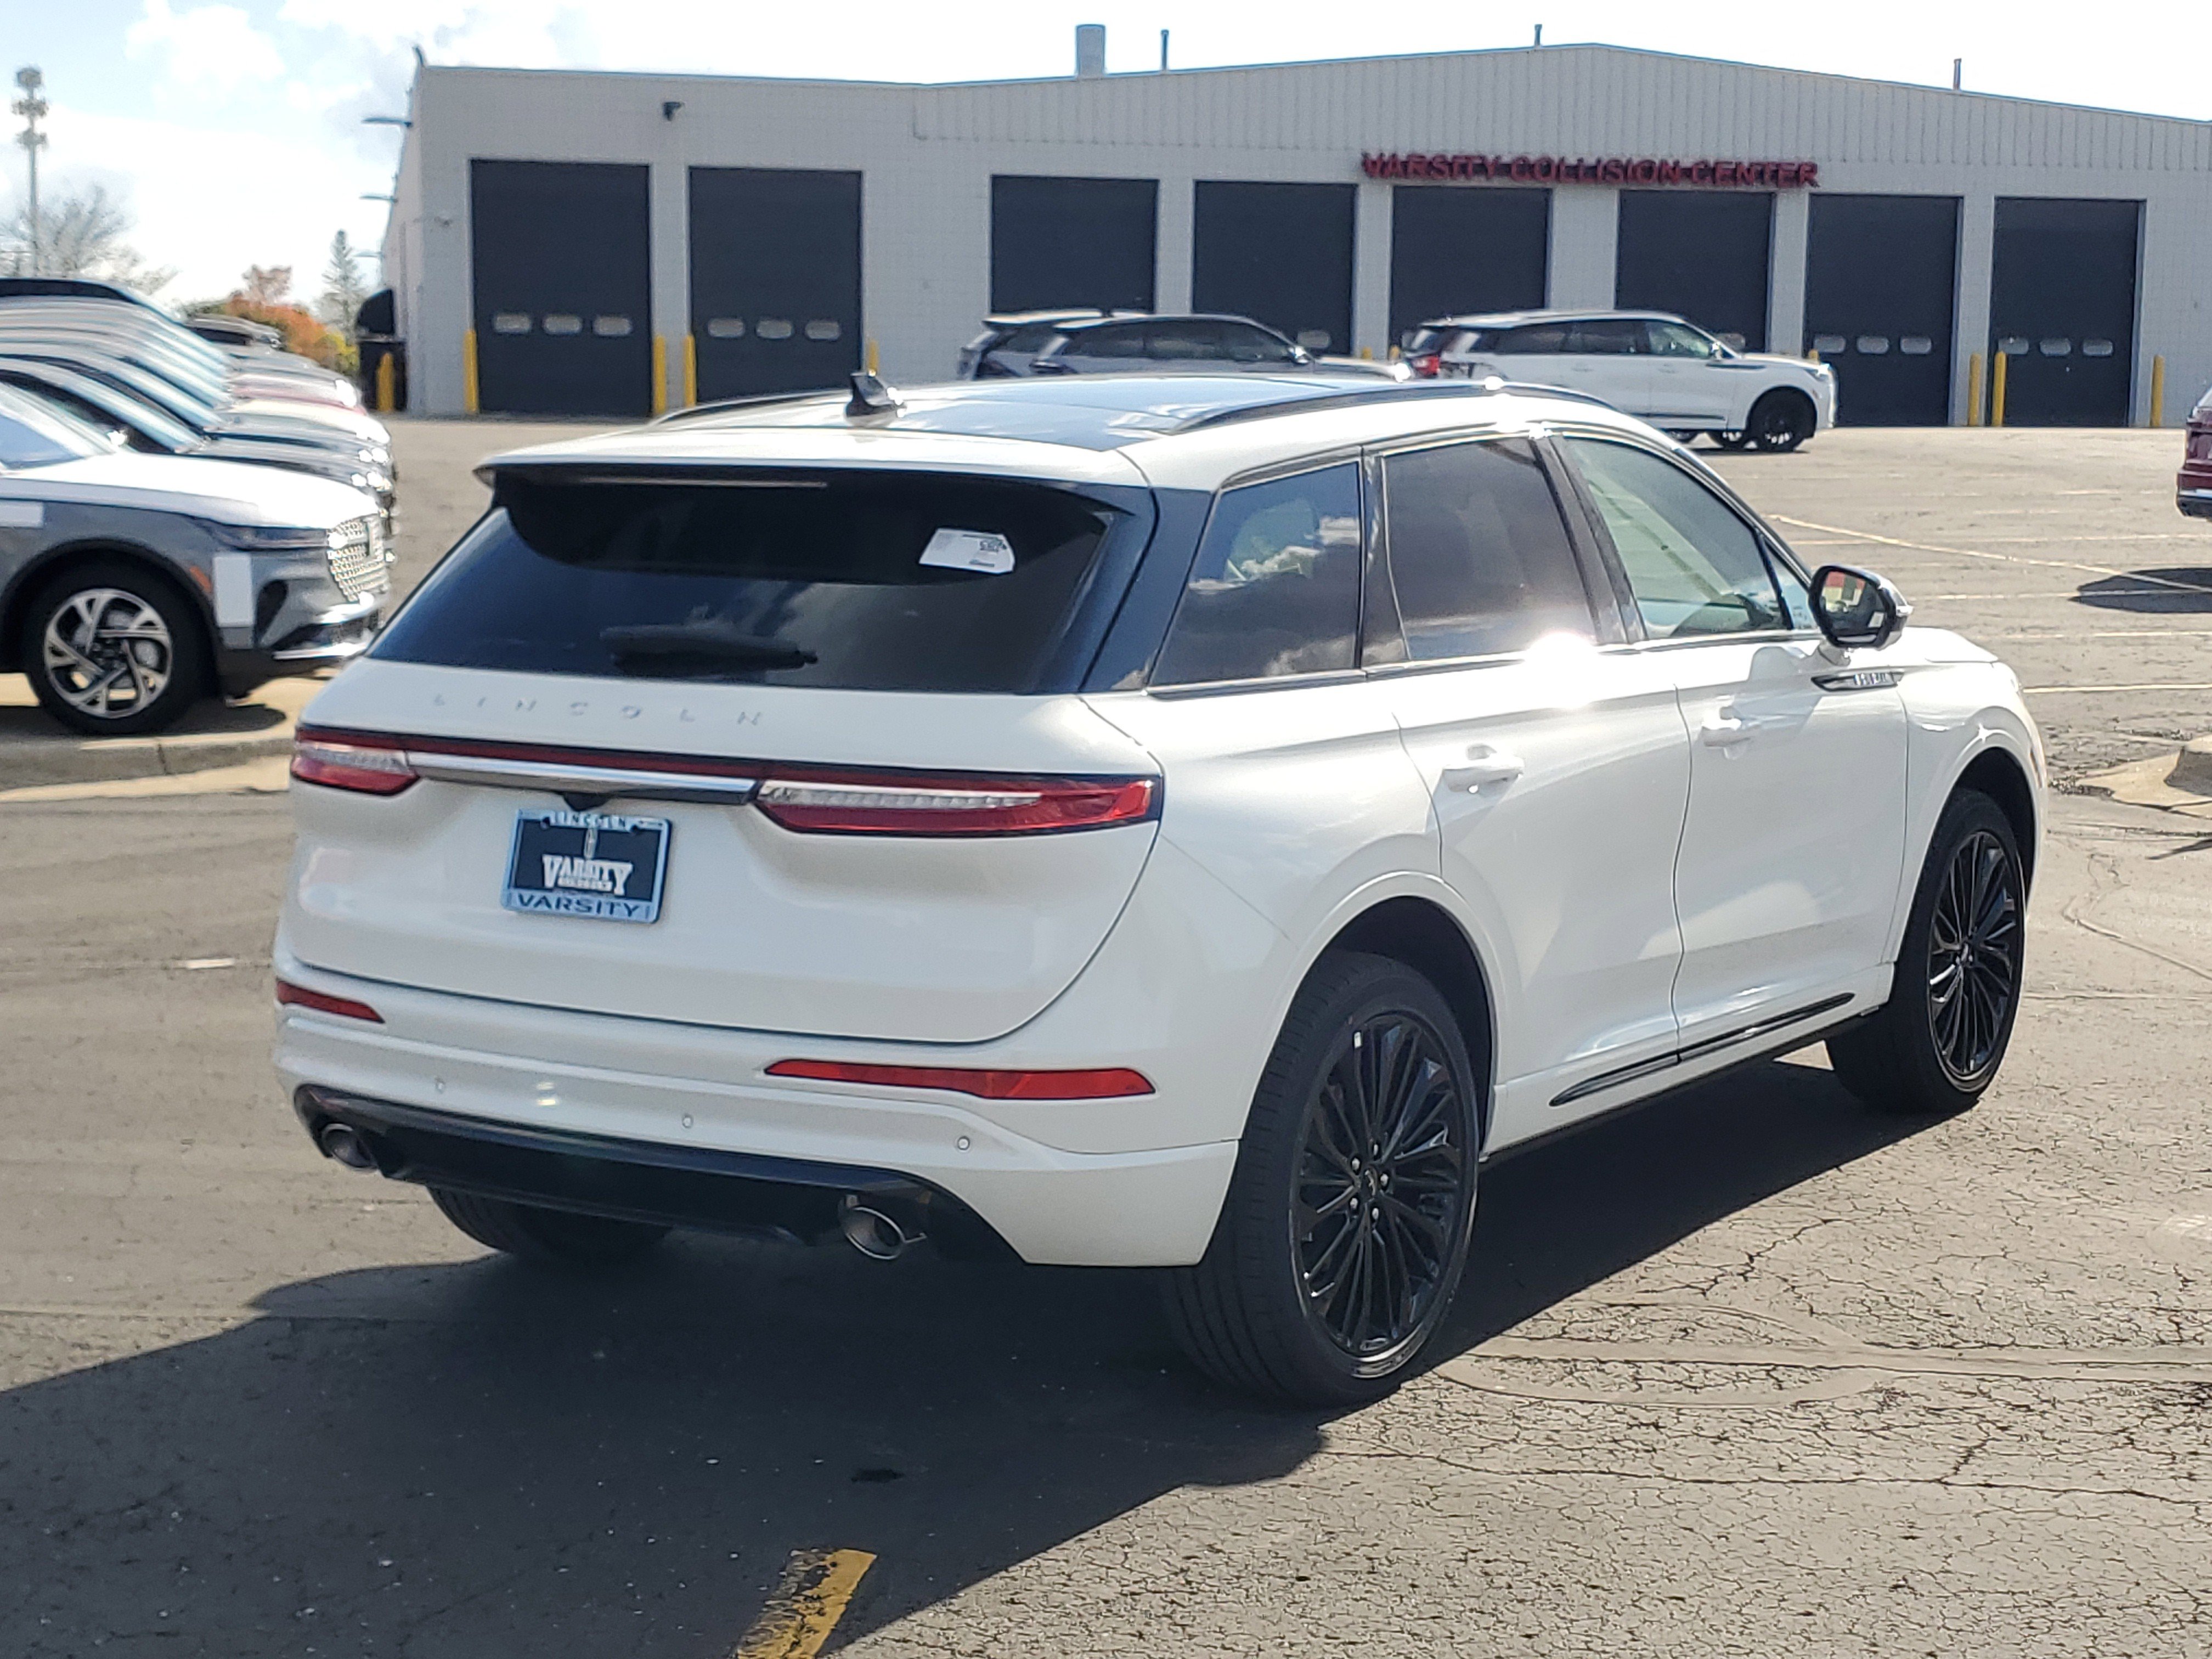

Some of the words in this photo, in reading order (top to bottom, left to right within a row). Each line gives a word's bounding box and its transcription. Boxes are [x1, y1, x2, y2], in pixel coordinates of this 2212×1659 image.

[1361, 152, 1501, 180] VARSITY
[1511, 155, 1680, 185] COLLISION
[1691, 160, 1820, 188] CENTER
[433, 694, 761, 726] LINCOLN
[541, 854, 633, 896] VARSITY
[518, 893, 640, 917] VARSITY
